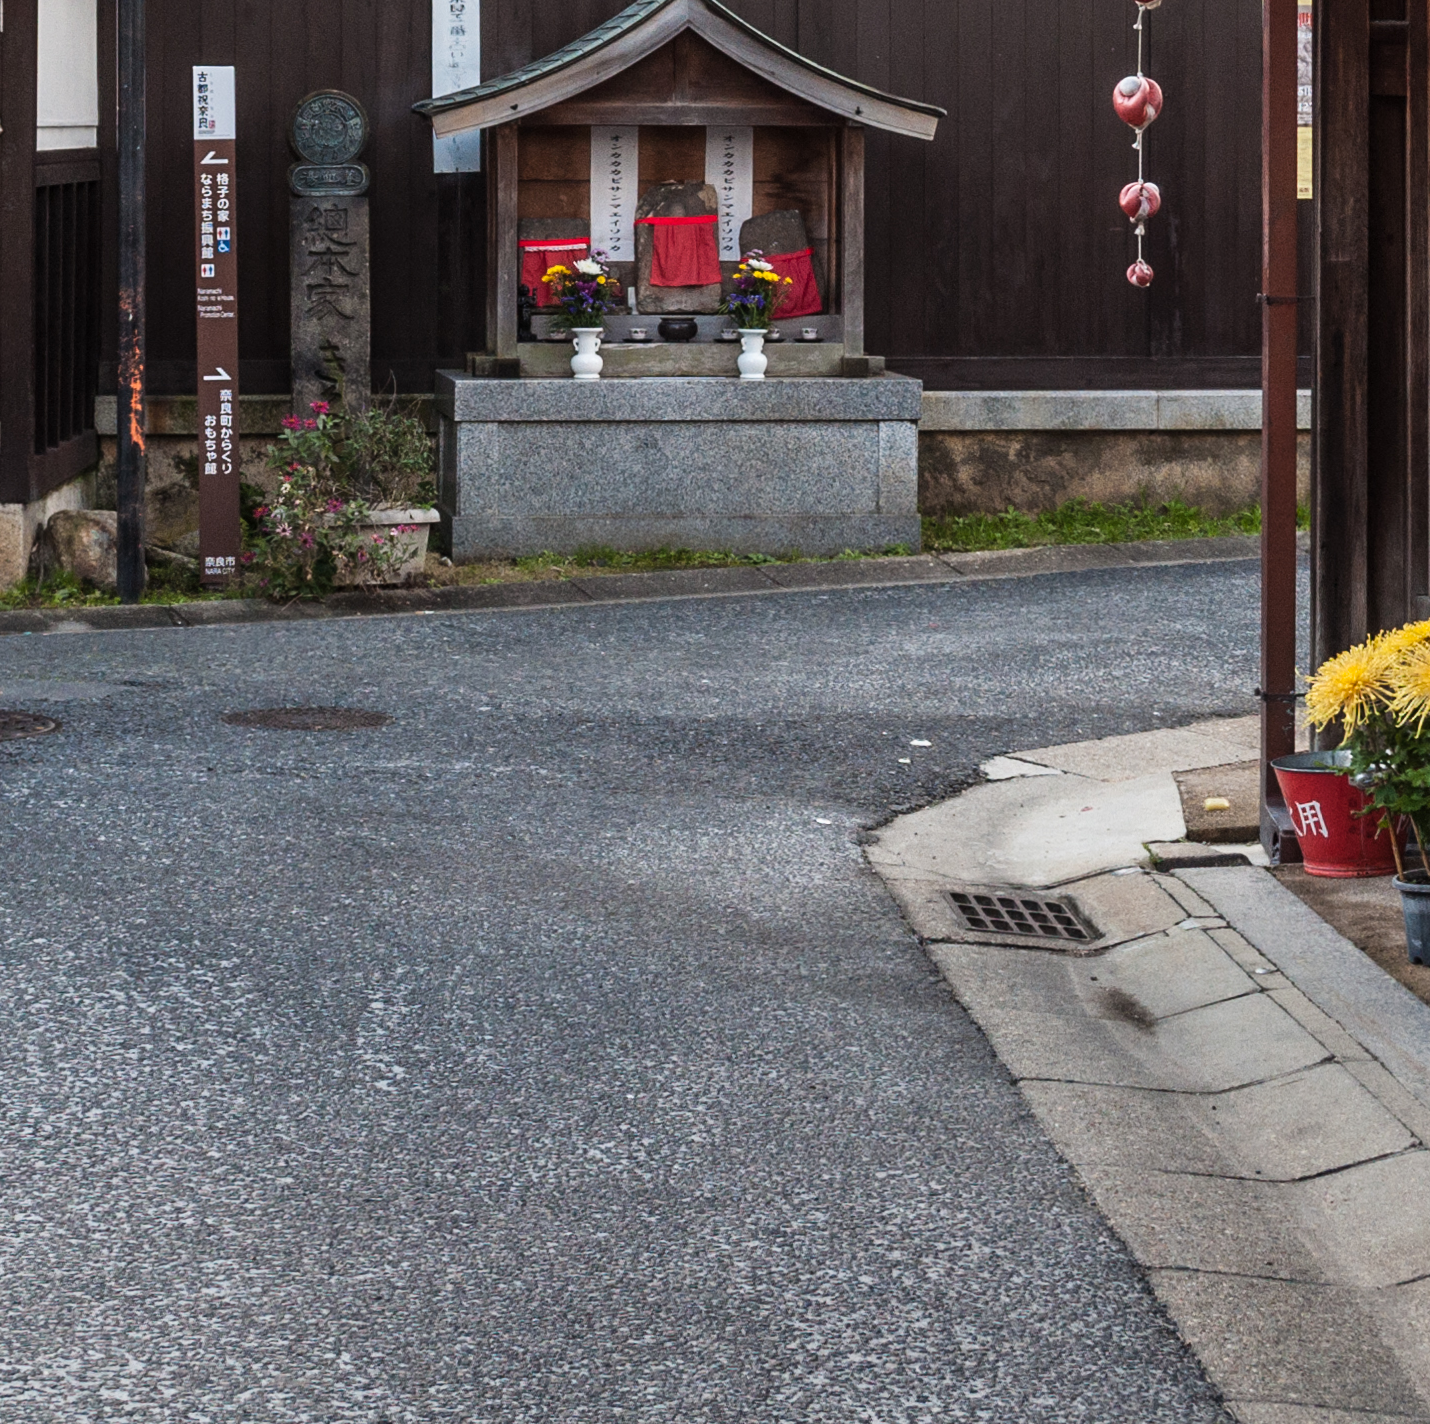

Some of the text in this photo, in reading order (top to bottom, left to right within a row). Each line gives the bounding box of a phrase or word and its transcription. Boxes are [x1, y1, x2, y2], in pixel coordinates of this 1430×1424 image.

[200, 173, 214, 259] ならまち振興館
[217, 173, 229, 223] 格子の家
[204, 415, 217, 474] おもちゃ館
[220, 389, 232, 474] 奈良町からくり
[205, 557, 235, 567] 奈良市
